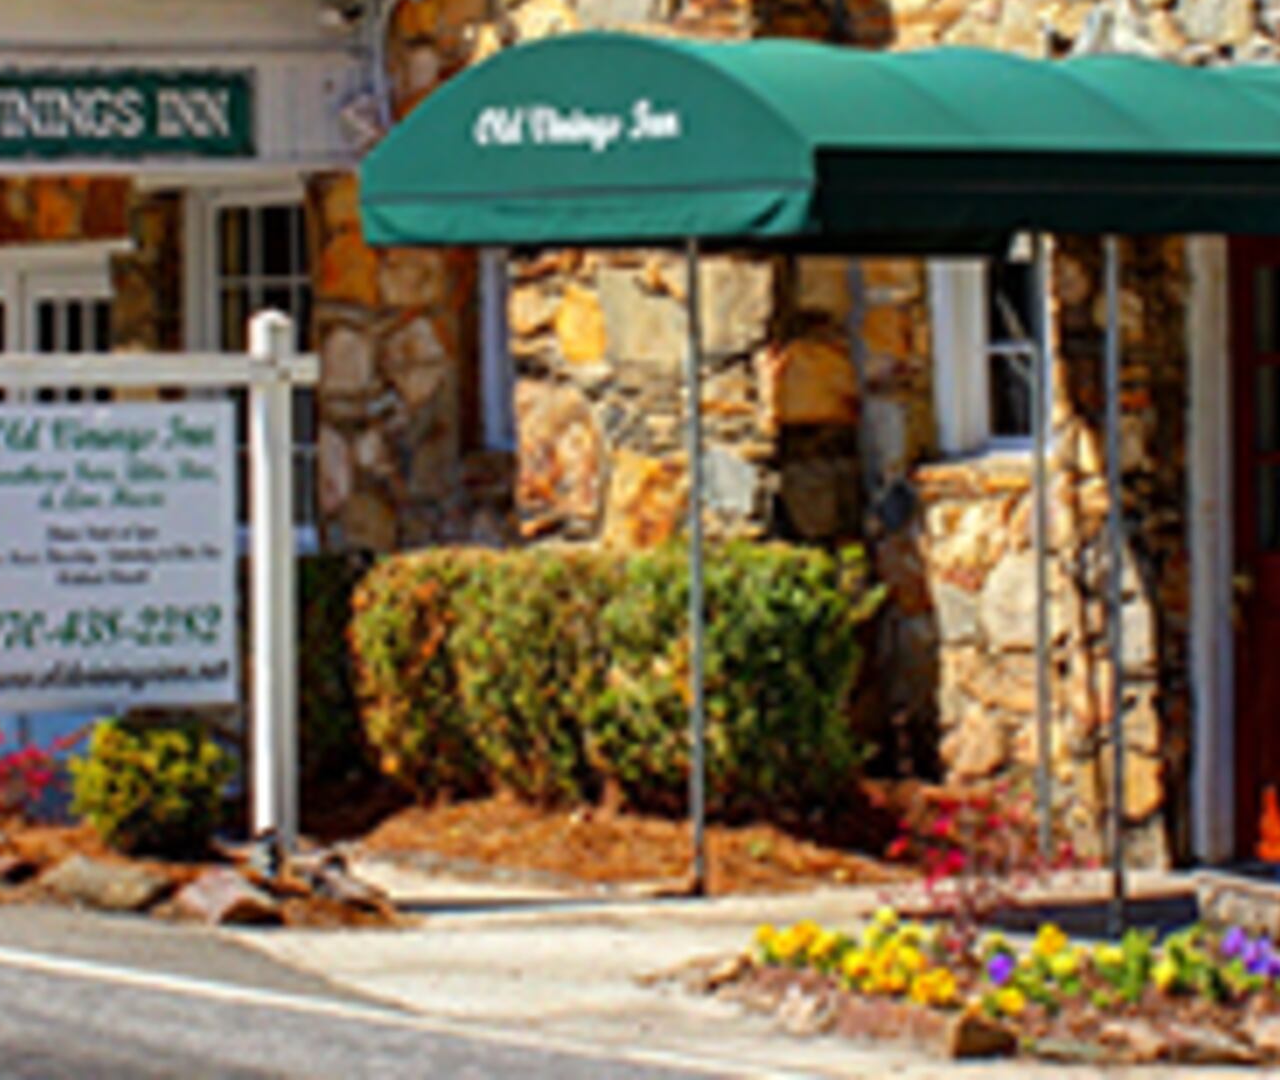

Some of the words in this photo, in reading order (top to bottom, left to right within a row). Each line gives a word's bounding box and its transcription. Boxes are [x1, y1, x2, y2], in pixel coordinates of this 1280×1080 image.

[155, 88, 231, 138] INN
[474, 107, 523, 145] Old
[627, 98, 681, 141] Inn
